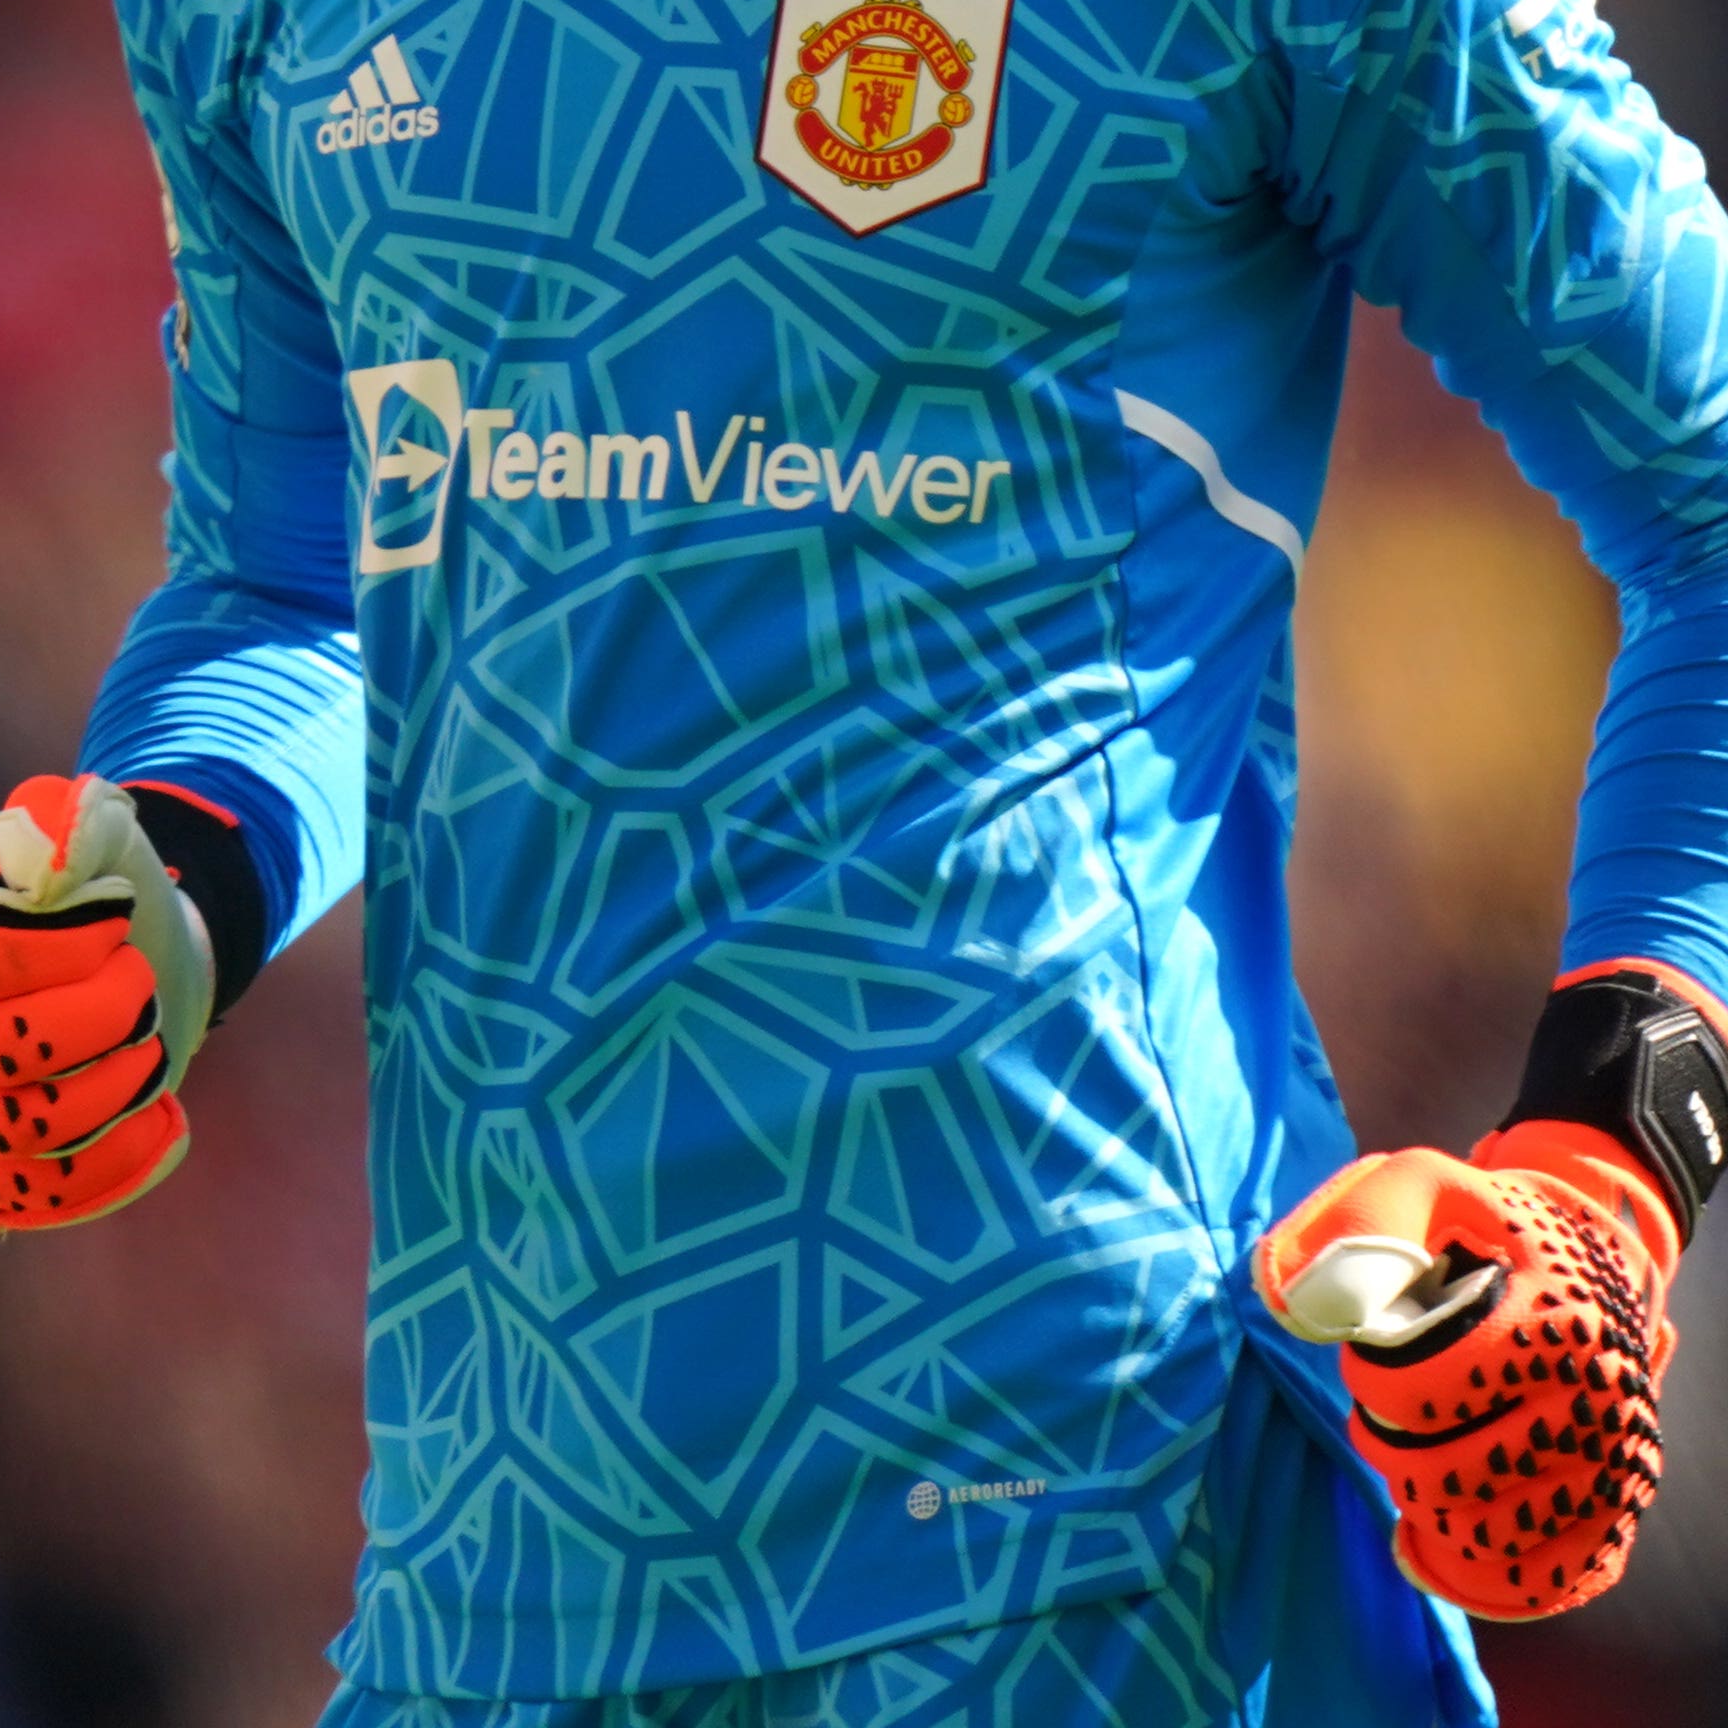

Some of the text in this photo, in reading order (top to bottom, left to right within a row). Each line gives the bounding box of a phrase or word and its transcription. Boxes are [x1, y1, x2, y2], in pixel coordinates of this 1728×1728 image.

[810, 9, 960, 79] MANCHESTER
[315, 103, 440, 155] adidas
[819, 138, 924, 177] UNITED
[463, 408, 1011, 524] TeamViewer
[949, 1479, 1047, 1503] AEROREADY
